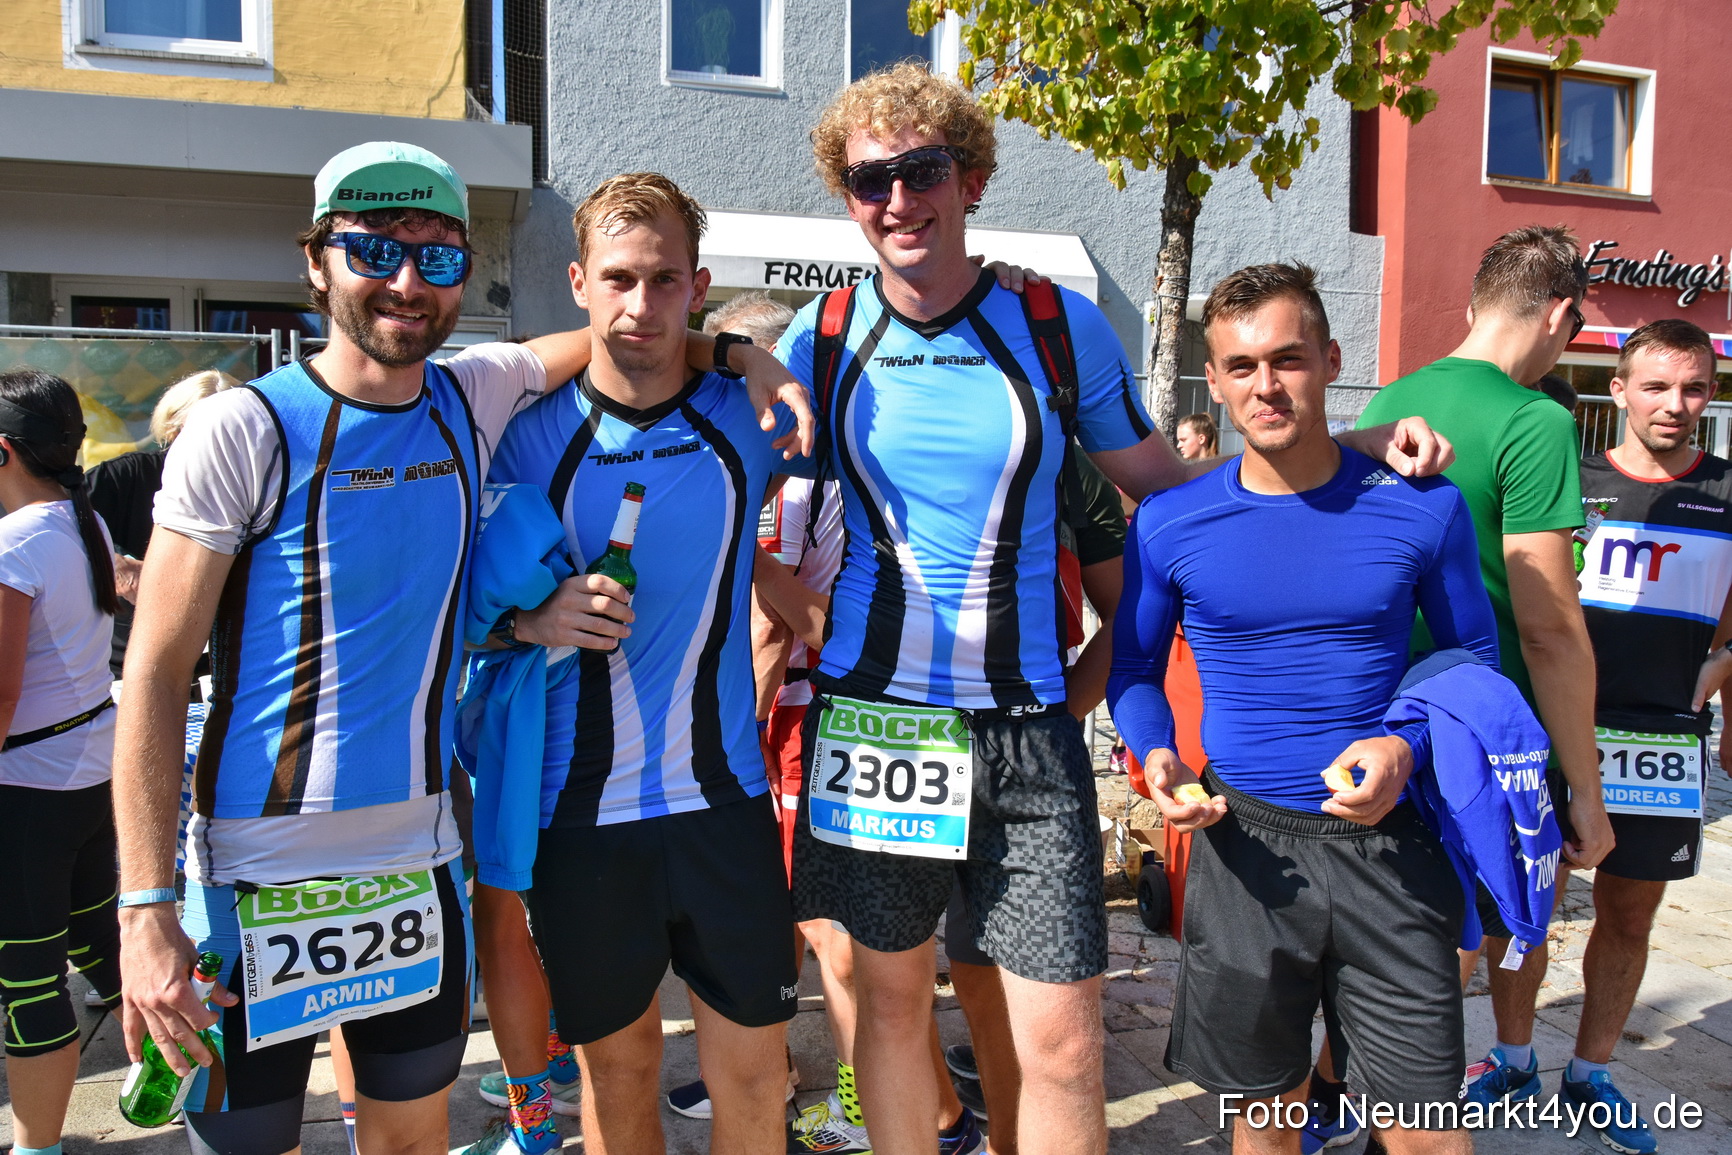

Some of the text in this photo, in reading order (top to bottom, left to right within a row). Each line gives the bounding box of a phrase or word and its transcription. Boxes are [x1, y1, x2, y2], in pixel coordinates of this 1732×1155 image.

[337, 186, 433, 201] Bianchi
[1583, 240, 1725, 307] Ernsting's
[1600, 537, 1682, 582] mr
[827, 704, 958, 747] BOCK
[826, 749, 950, 806] 2303
[1602, 787, 1682, 805] NDREAS
[831, 808, 936, 839] MARKUS
[253, 875, 420, 921] BOCK
[266, 909, 426, 987] 2628
[302, 976, 395, 1019] ARMIN
